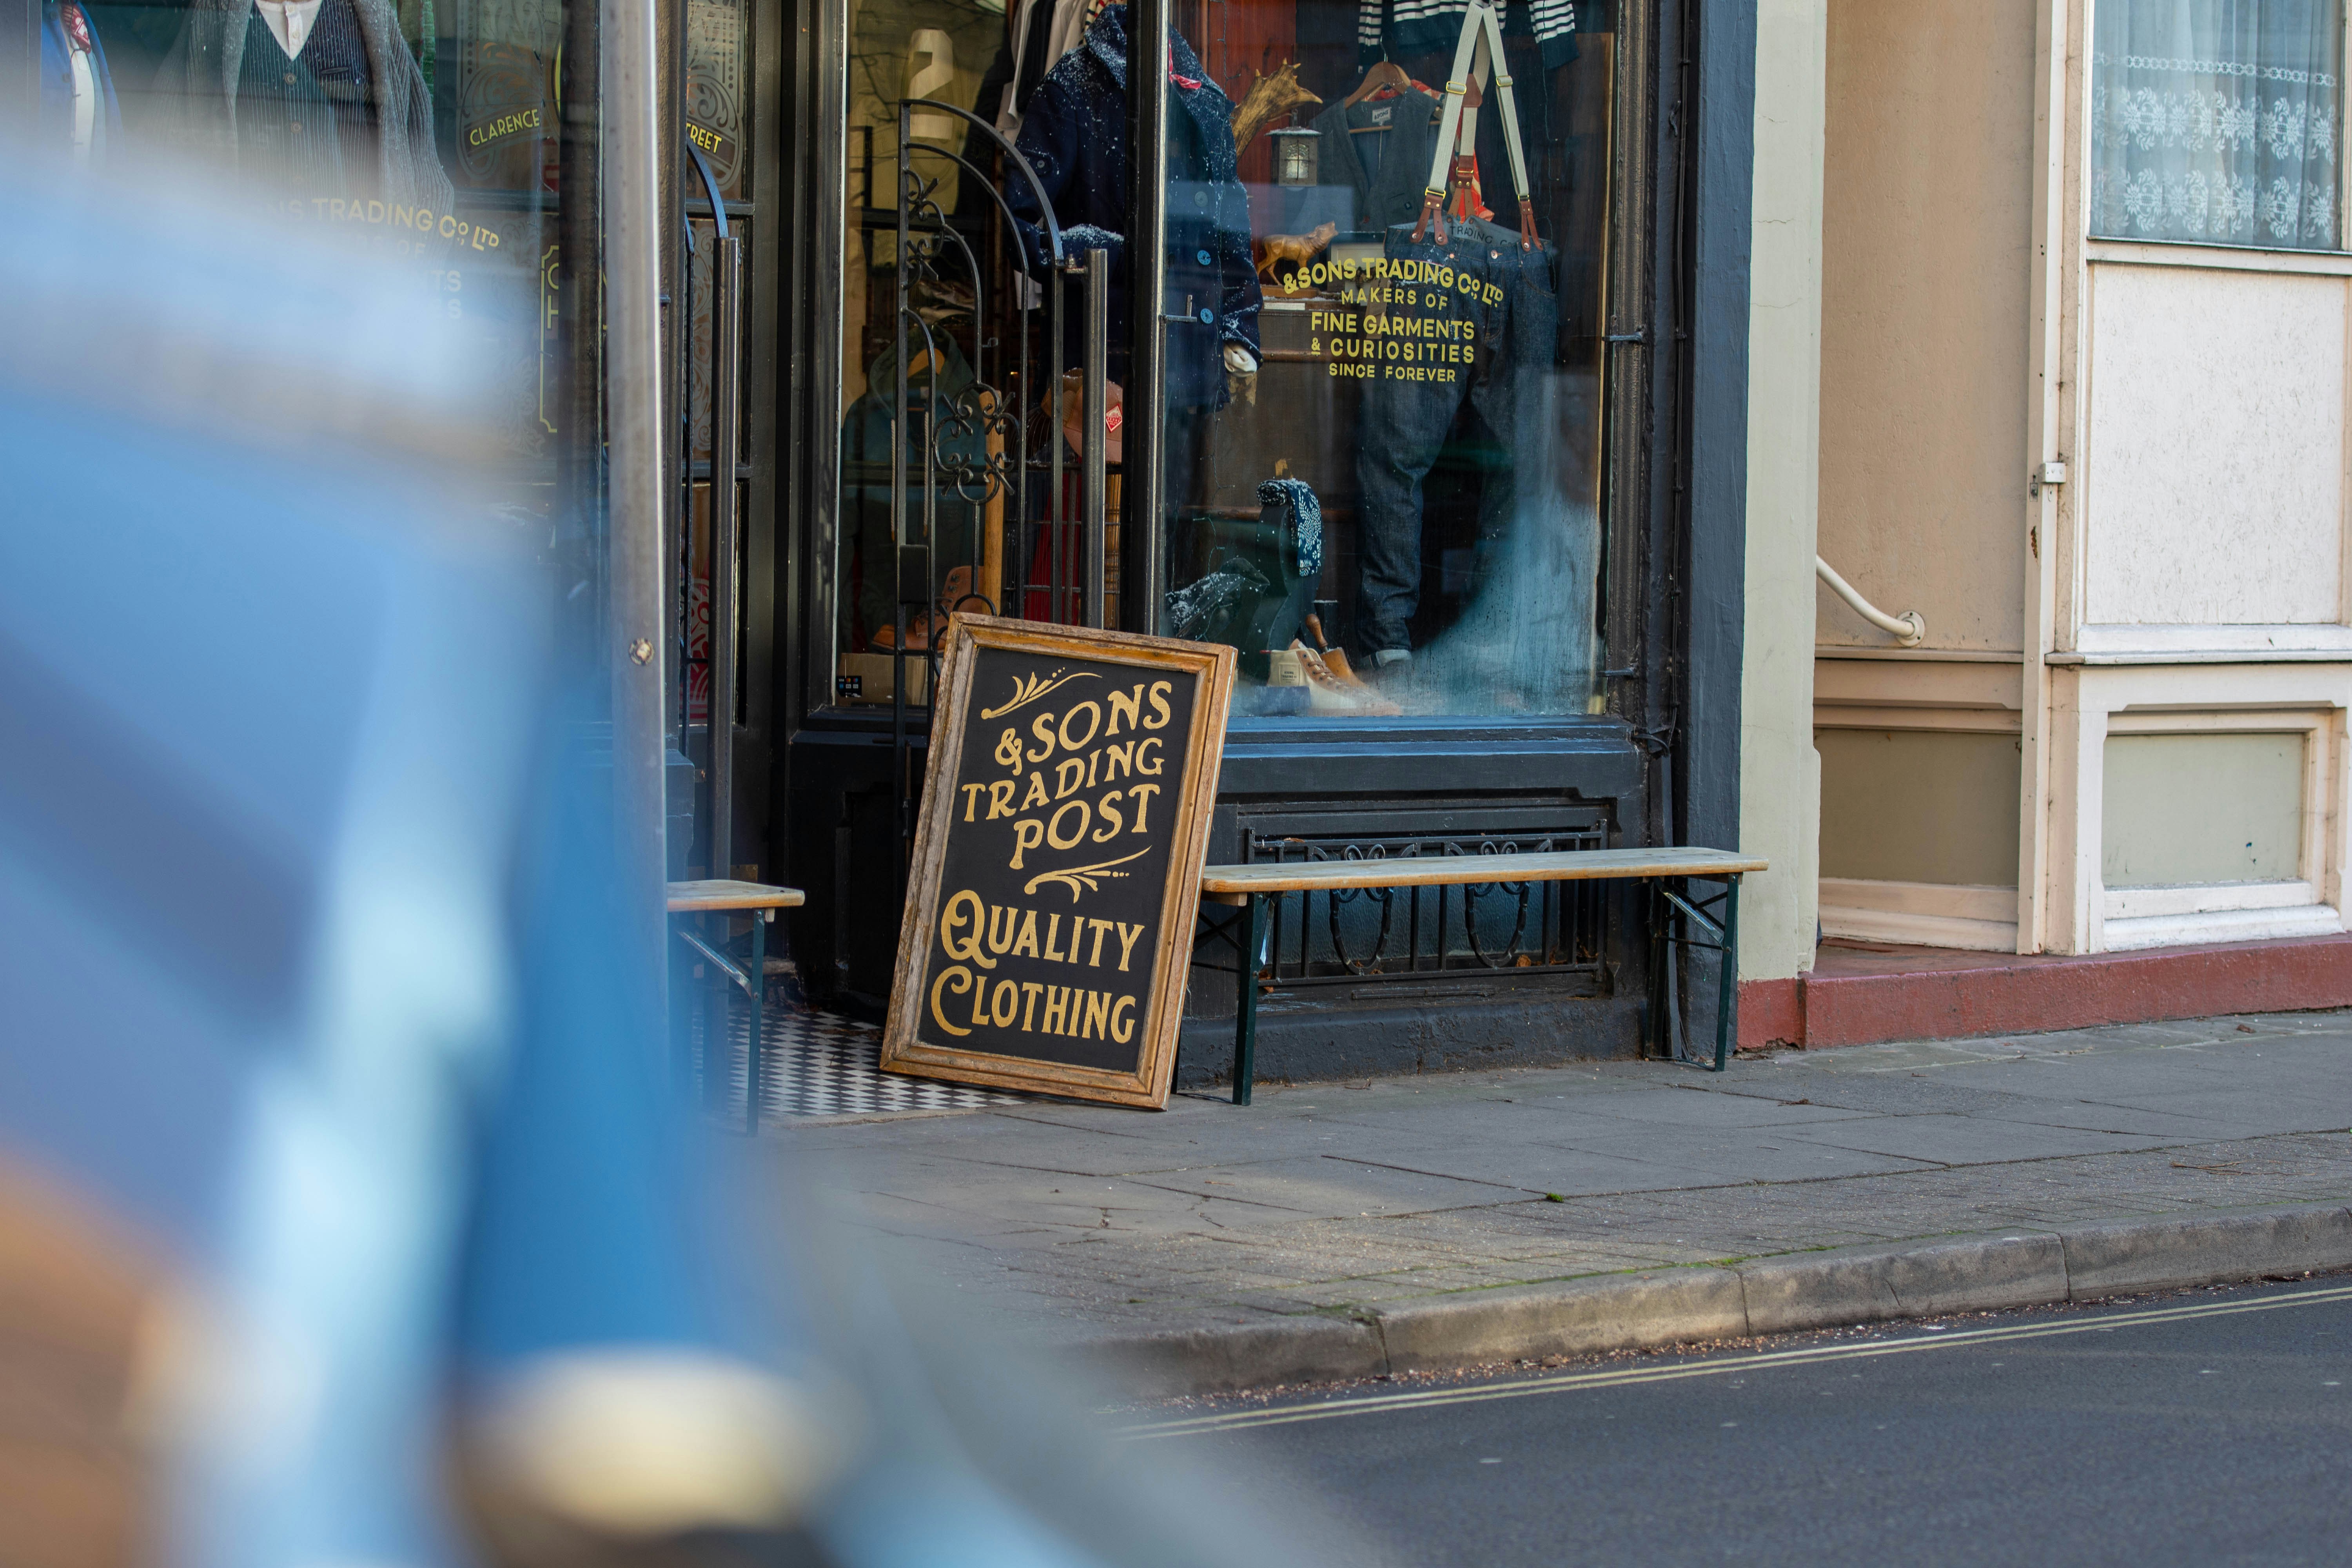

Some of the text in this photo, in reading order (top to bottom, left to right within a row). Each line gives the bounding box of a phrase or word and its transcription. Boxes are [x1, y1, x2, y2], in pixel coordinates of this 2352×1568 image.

[470, 109, 540, 145] CLARENCE
[312, 199, 433, 232] TRADING
[1450, 226, 1493, 244] TRADING
[1283, 258, 1356, 294] &SONS
[1362, 258, 1454, 288] TRADING
[1341, 287, 1448, 310] MAKERS OF
[1311, 312, 1474, 340] FINE GARMENTS
[1311, 338, 1474, 363] & CURIOSITIES
[1329, 363, 1455, 382] SINCE FOREVER
[962, 737, 1165, 822] TRADING
[1009, 783, 1160, 870] POST
[940, 889, 1145, 972] QUALITY
[931, 965, 1136, 1044] CLOTHING
